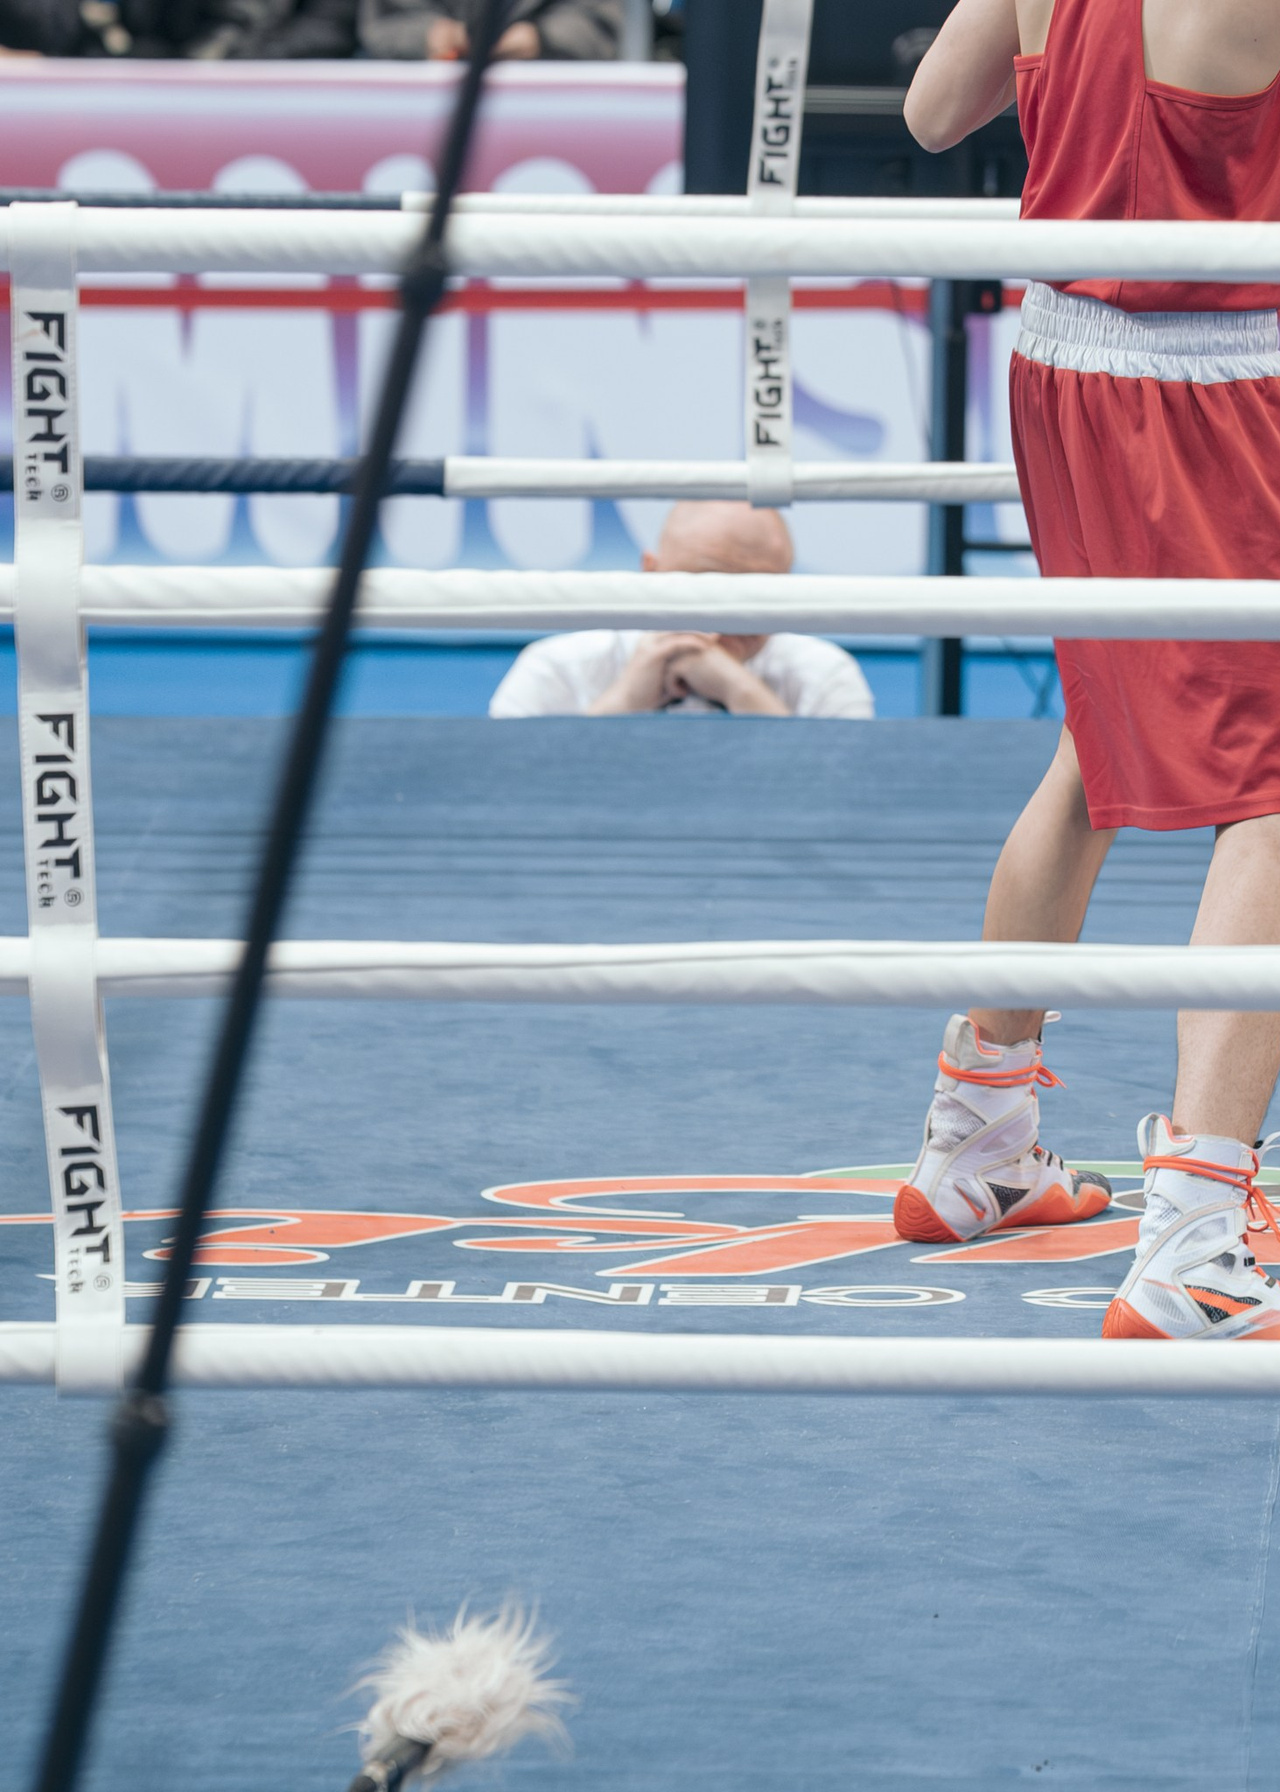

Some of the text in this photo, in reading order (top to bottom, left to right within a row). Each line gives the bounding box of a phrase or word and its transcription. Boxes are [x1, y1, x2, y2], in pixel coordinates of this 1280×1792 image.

[760, 75, 791, 186] FIGHT
[25, 312, 68, 474] FIGHT
[755, 337, 782, 446] FIGHT
[35, 713, 81, 879] FIGHT
[56, 1105, 111, 1263] FIGHT
